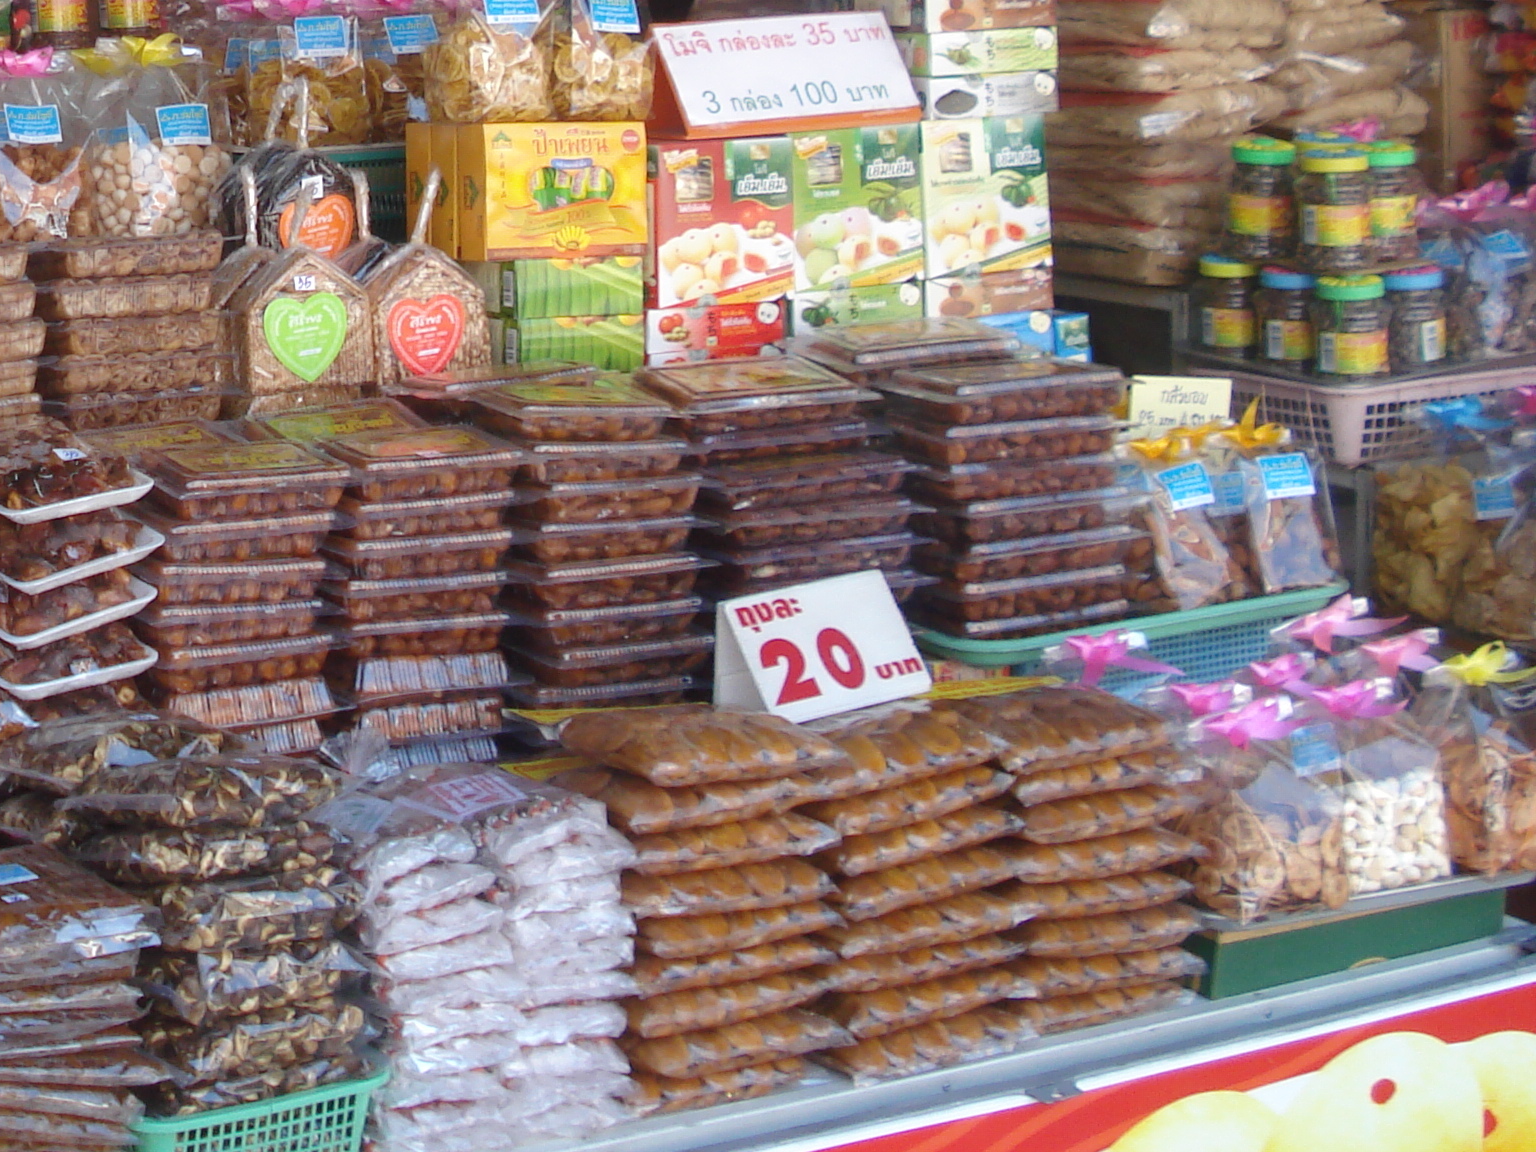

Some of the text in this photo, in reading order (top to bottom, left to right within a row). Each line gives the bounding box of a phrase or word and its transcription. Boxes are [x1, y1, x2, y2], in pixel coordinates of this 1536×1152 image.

[662, 22, 886, 58] โมจิ กล่องละ 35 บาท
[701, 79, 890, 115] 3 กล่อง 100 บาท
[733, 597, 803, 633] ถุงละ
[760, 627, 924, 707] 20 บาท
